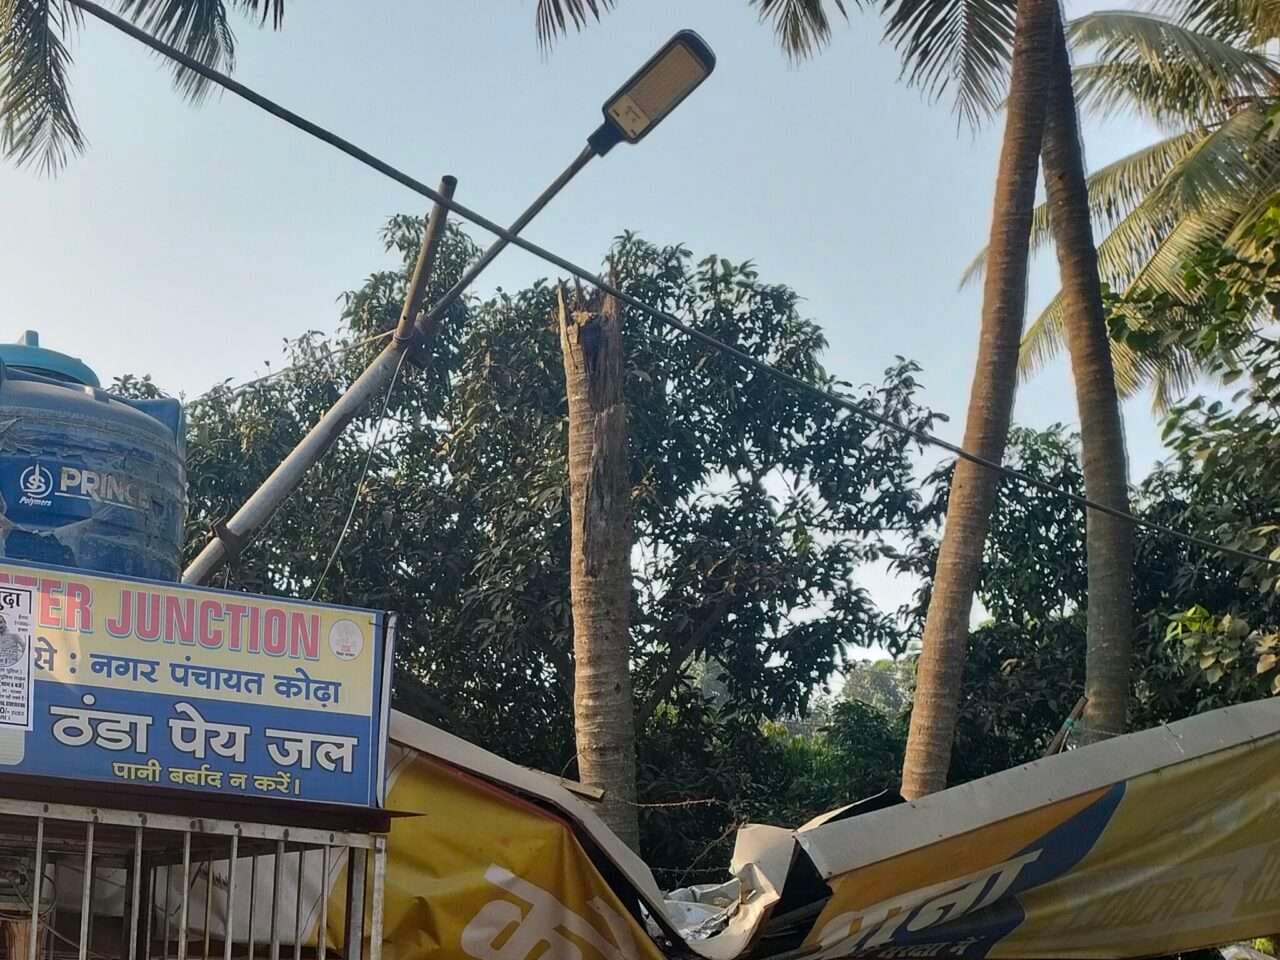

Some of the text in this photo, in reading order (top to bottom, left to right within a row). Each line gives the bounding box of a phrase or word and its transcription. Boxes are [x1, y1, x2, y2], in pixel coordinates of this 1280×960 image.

[106, 589, 320, 661] JUNCTION
[90, 652, 160, 683] नगर
[170, 655, 265, 695] पंचायत
[273, 666, 342, 708] कोढ़ा
[49, 693, 358, 773] ठंडा पेय जल
[113, 758, 162, 782] पानी
[168, 764, 223, 788] बर्बाद
[230, 773, 248, 789] न
